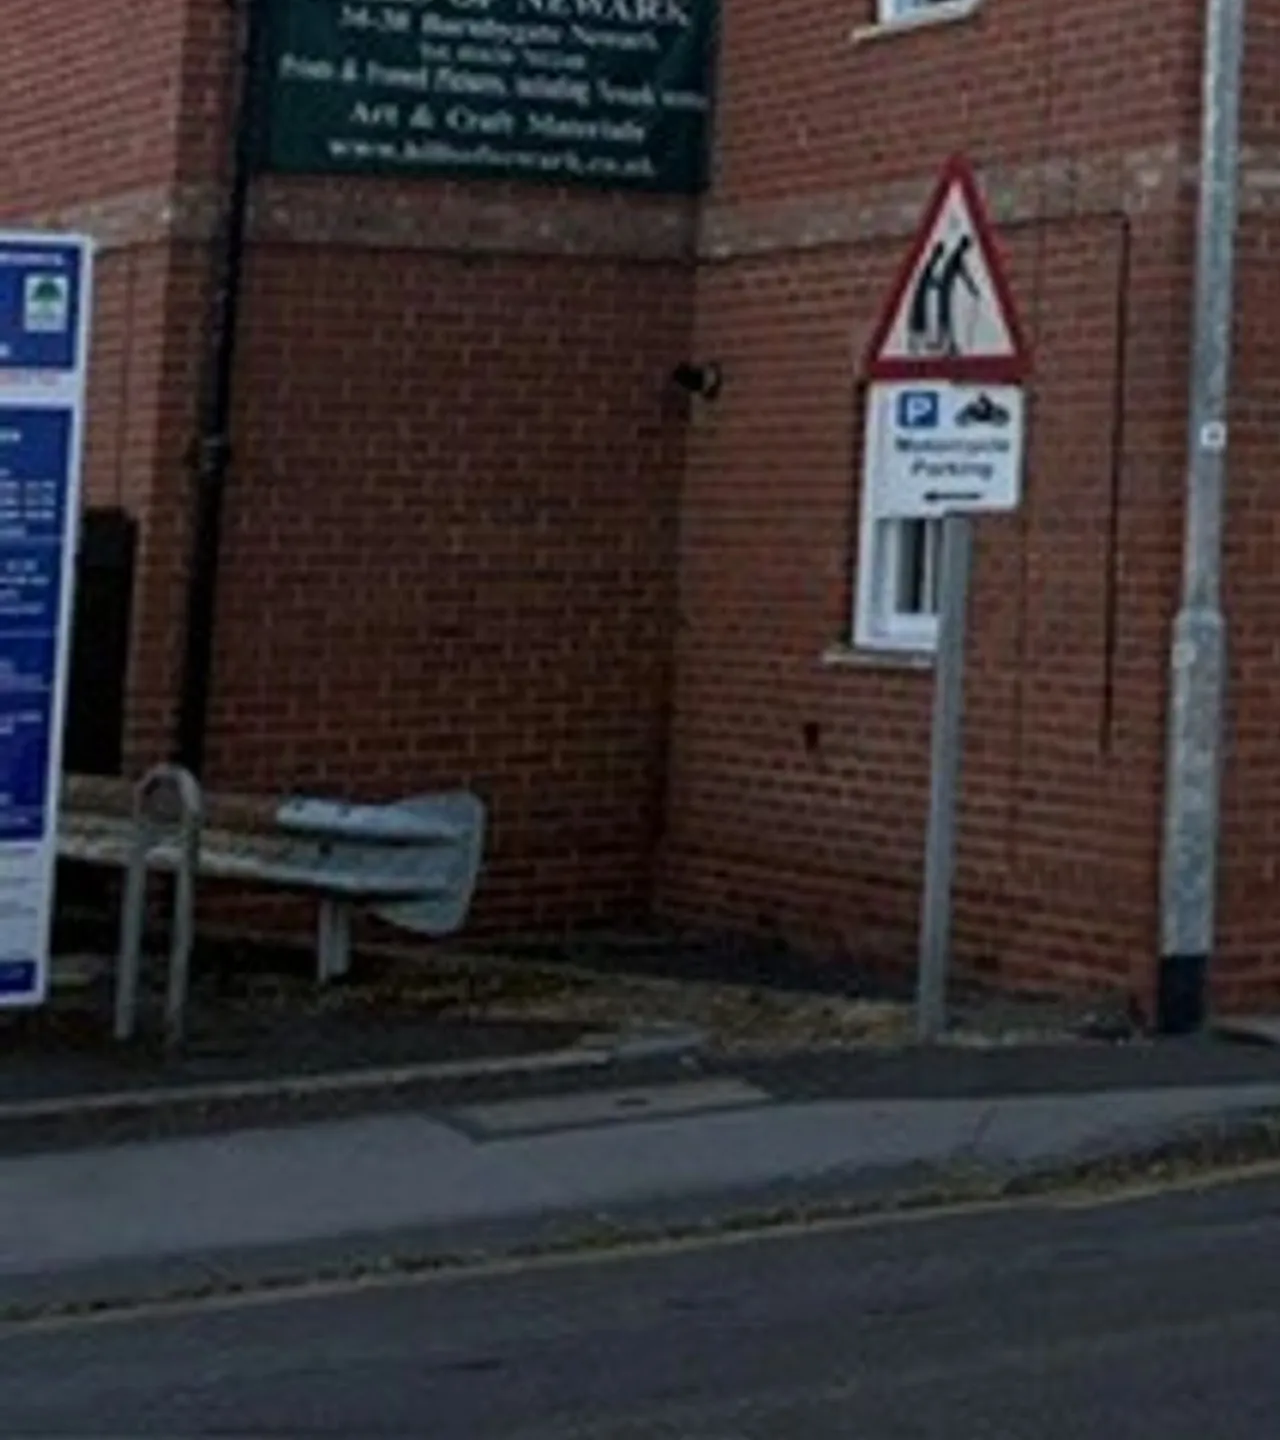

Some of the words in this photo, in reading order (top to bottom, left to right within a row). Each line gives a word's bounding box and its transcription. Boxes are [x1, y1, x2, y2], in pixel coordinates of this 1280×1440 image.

[570, 23, 659, 51] Newark
[349, 101, 399, 127] Art
[408, 104, 435, 129] &
[445, 107, 516, 135] Craft
[526, 113, 646, 143] Materials
[907, 398, 931, 425] P
[911, 457, 994, 483] Parking
